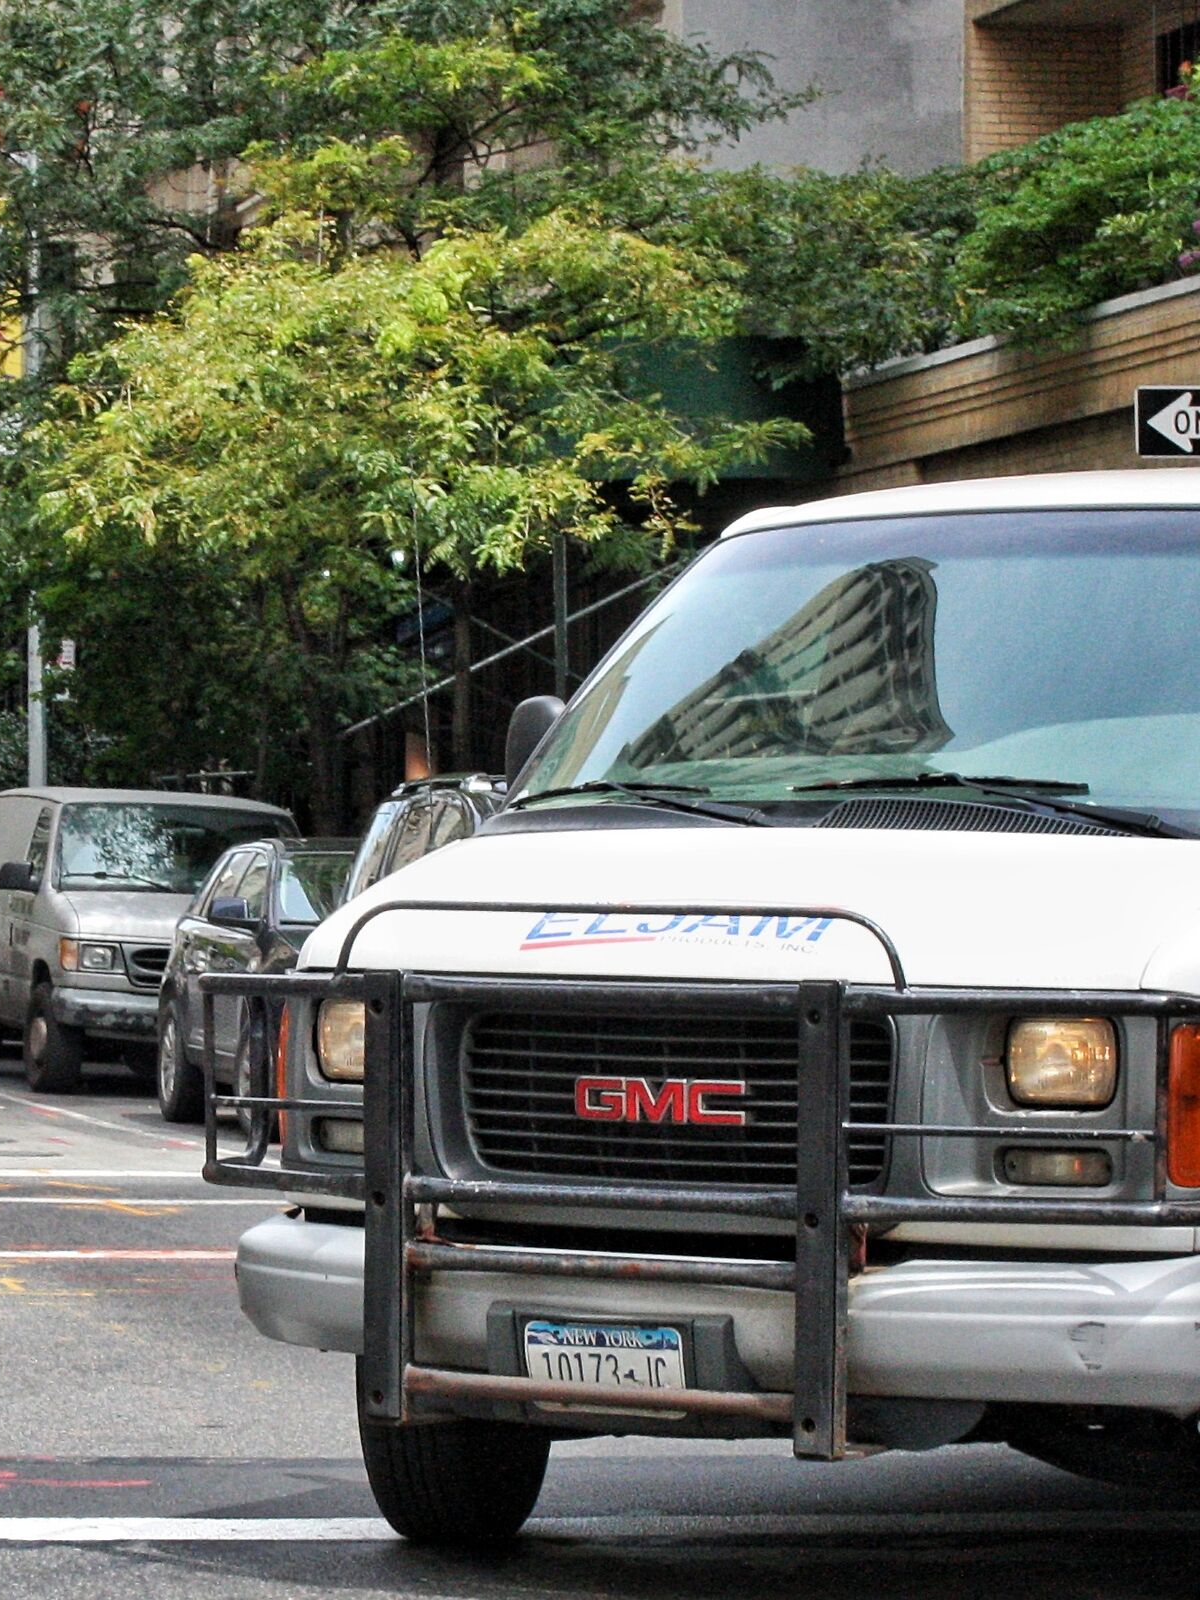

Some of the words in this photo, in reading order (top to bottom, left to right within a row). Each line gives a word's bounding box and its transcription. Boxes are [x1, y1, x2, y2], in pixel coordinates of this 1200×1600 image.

[575, 1075, 746, 1126] GMC
[562, 1328, 597, 1346] NEW
[600, 1331, 644, 1348] YORK
